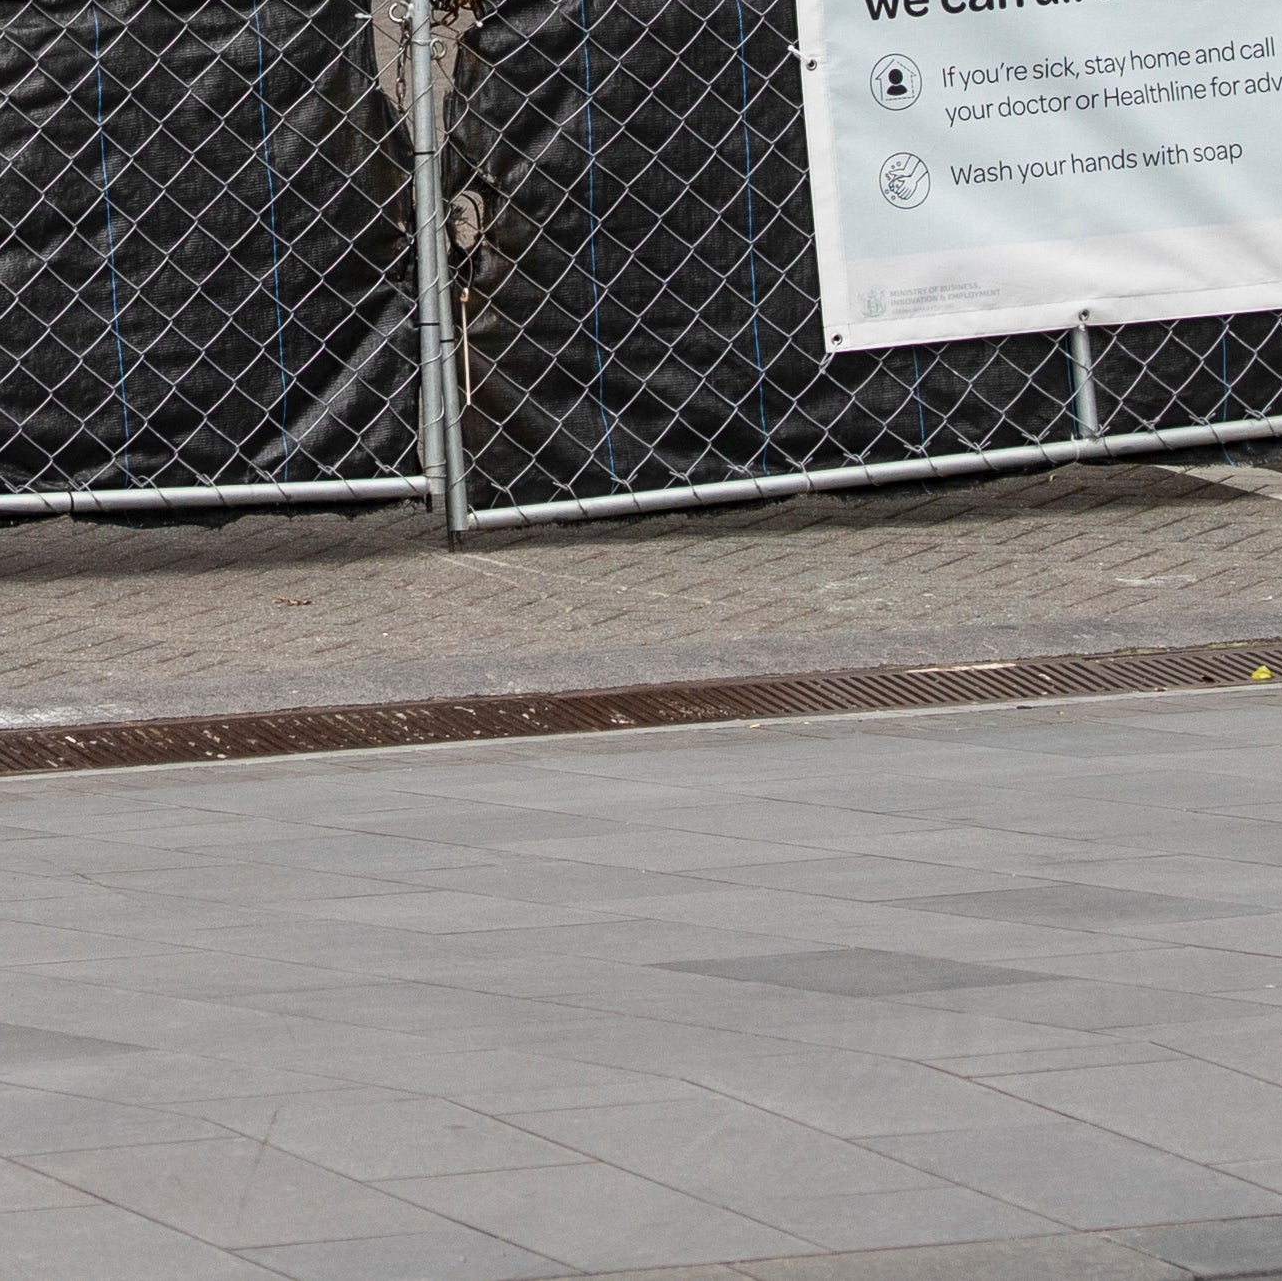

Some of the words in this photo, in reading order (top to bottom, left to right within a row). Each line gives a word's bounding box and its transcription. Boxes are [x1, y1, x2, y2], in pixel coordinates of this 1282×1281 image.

[943, 66, 955, 87] If
[1033, 57, 1079, 79] sick,
[1085, 56, 1125, 77] stay
[1130, 50, 1190, 70] home
[1196, 41, 1235, 64] and
[1240, 37, 1275, 59] call
[945, 103, 993, 127] your
[998, 95, 1071, 117] doctor
[1076, 94, 1099, 110] or
[1104, 81, 1206, 107] Healthline
[1210, 77, 1240, 97] for
[951, 161, 1012, 185] Wash
[1017, 160, 1066, 184] your
[1071, 149, 1137, 173] hands
[1143, 144, 1188, 167] with
[1193, 144, 1242, 164] soap
